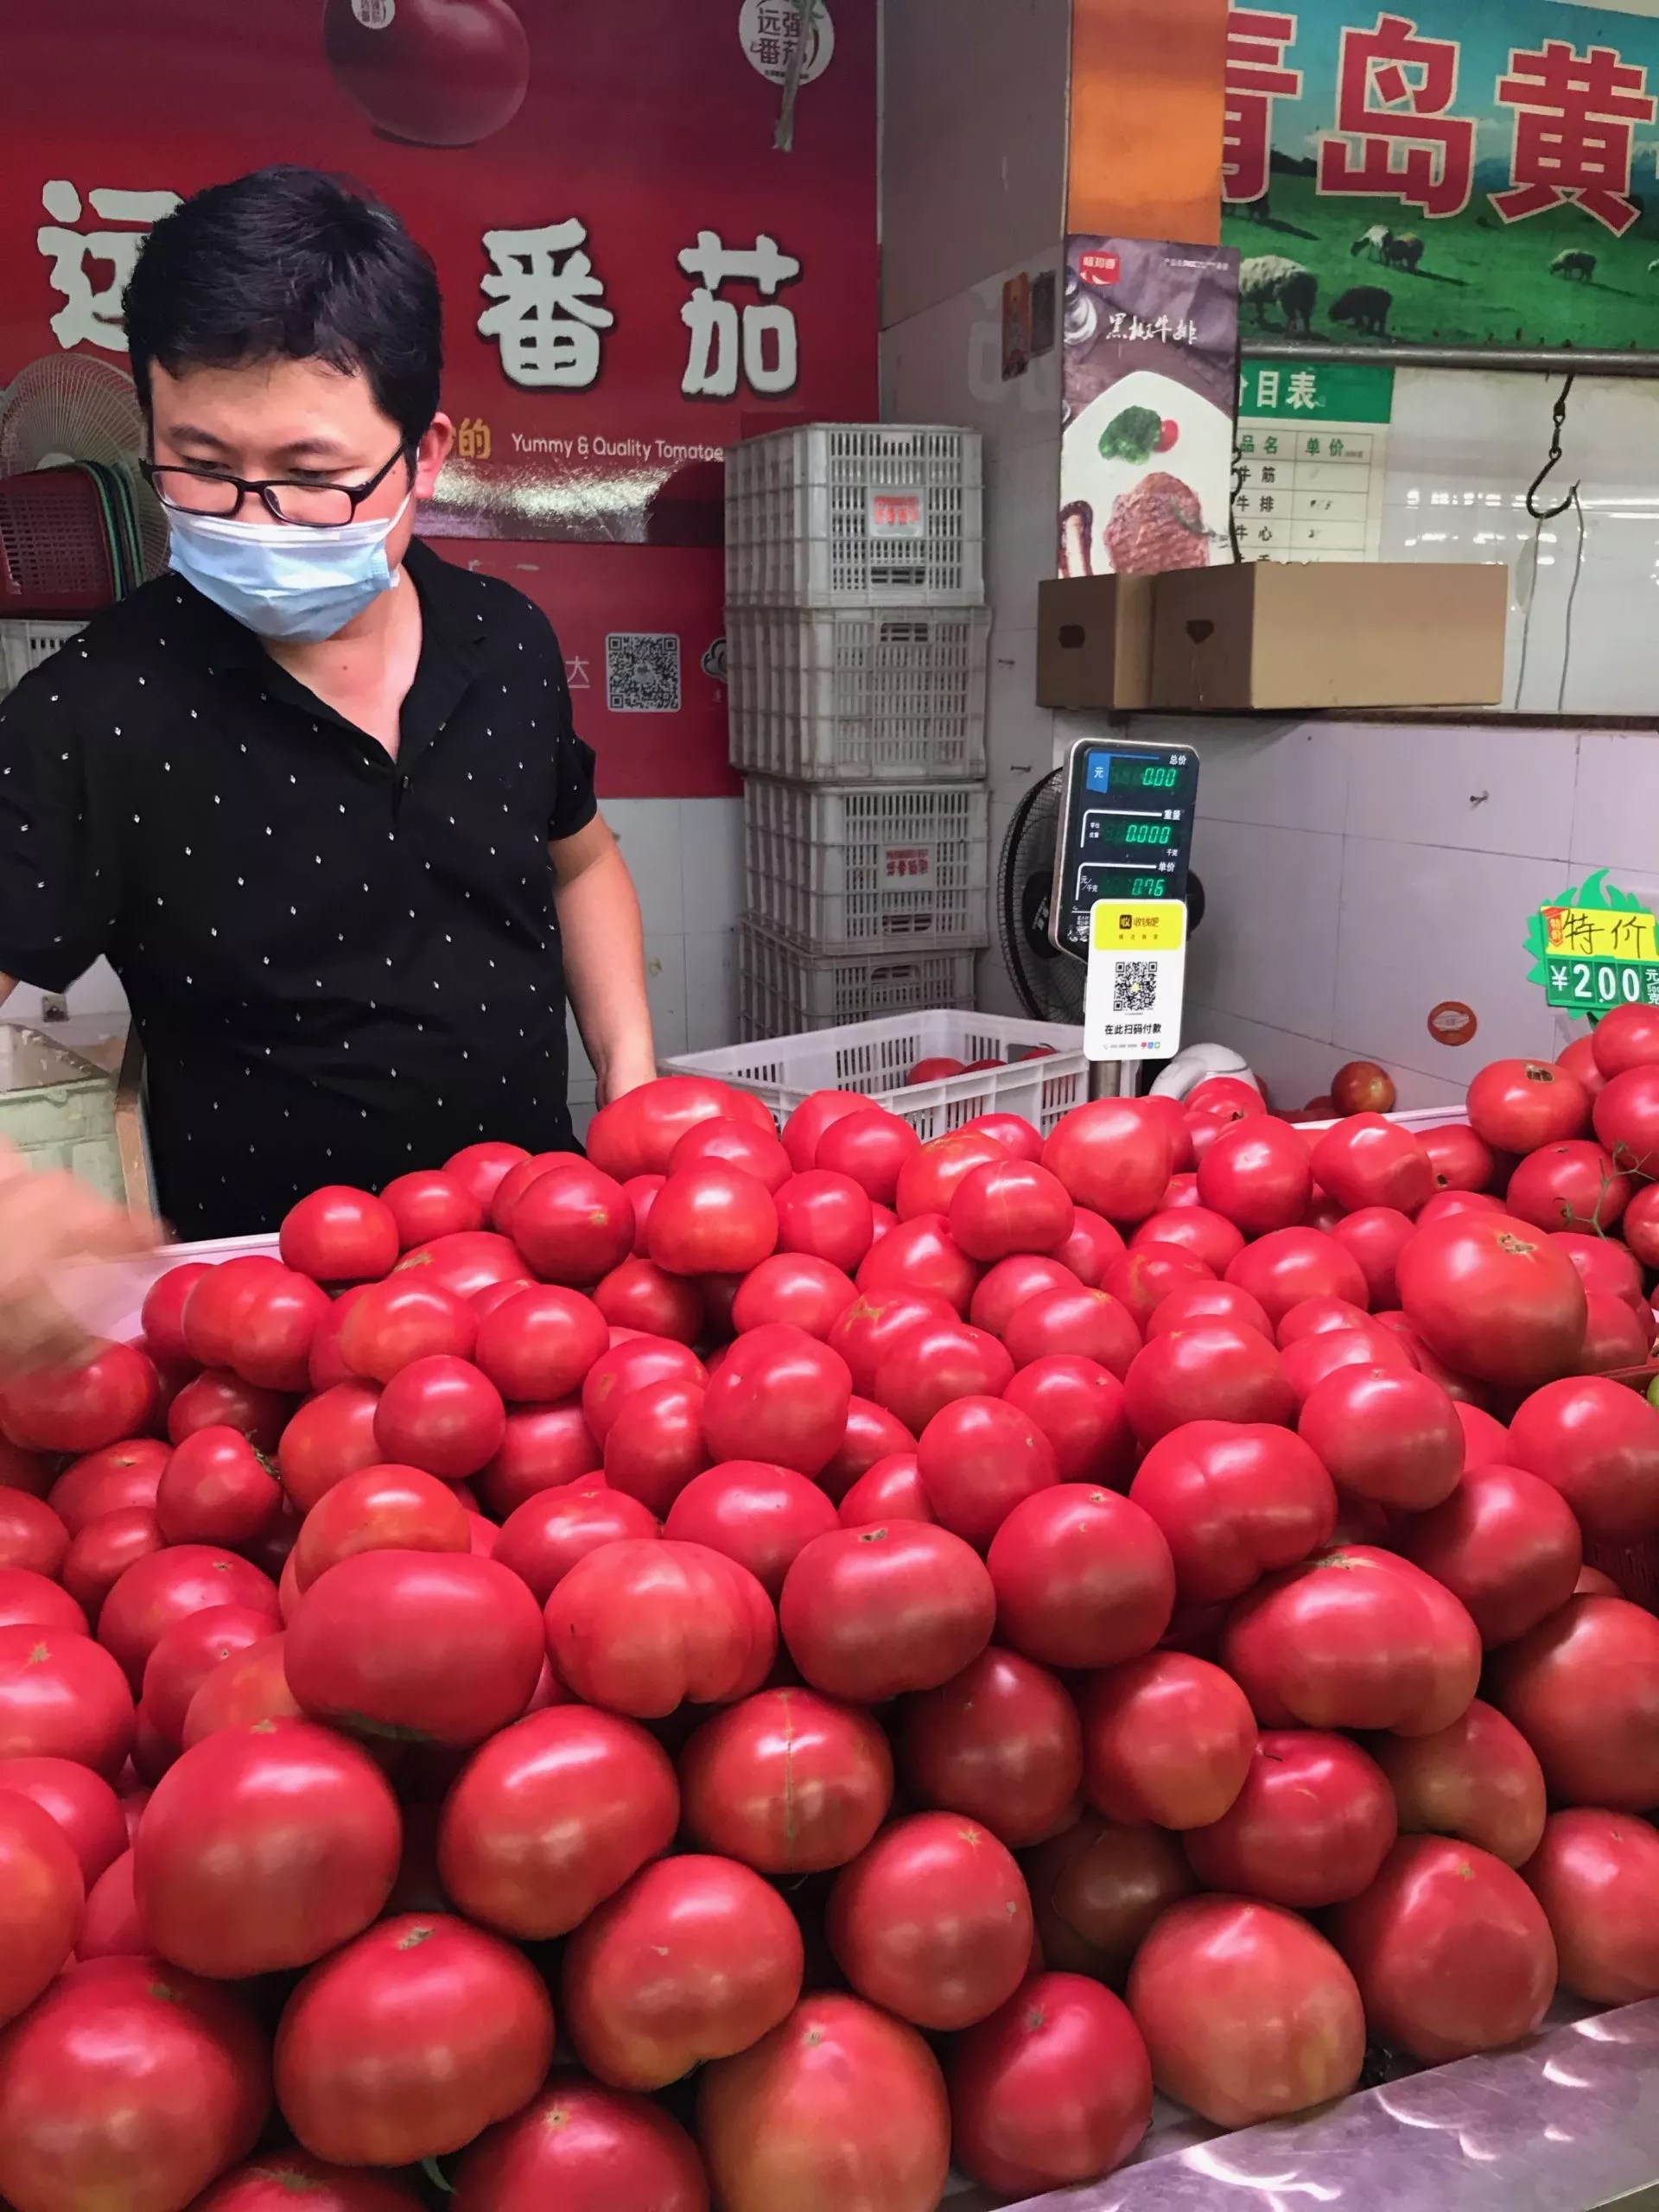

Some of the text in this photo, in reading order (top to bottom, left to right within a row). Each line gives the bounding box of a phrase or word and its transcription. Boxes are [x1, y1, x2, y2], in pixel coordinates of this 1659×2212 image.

[1239, 371, 1319, 410] 目表
[451, 417, 492, 460] 的
[512, 433, 574, 459] Yummy
[577, 435, 588, 455] &
[593, 436, 652, 461] Quality
[1240, 435, 1278, 454] 品名
[1306, 437, 1344, 457] 单价
[1236, 494, 1274, 513] 牛排
[1236, 524, 1273, 543] 牛心
[1169, 754, 1187, 766] 总价
[1093, 766, 1105, 779] 元
[1163, 810, 1181, 821] 重量
[1158, 861, 1176, 873] 单价
[1562, 909, 1647, 959] 特价
[1104, 1022, 1162, 1036] 在此扫码付款
